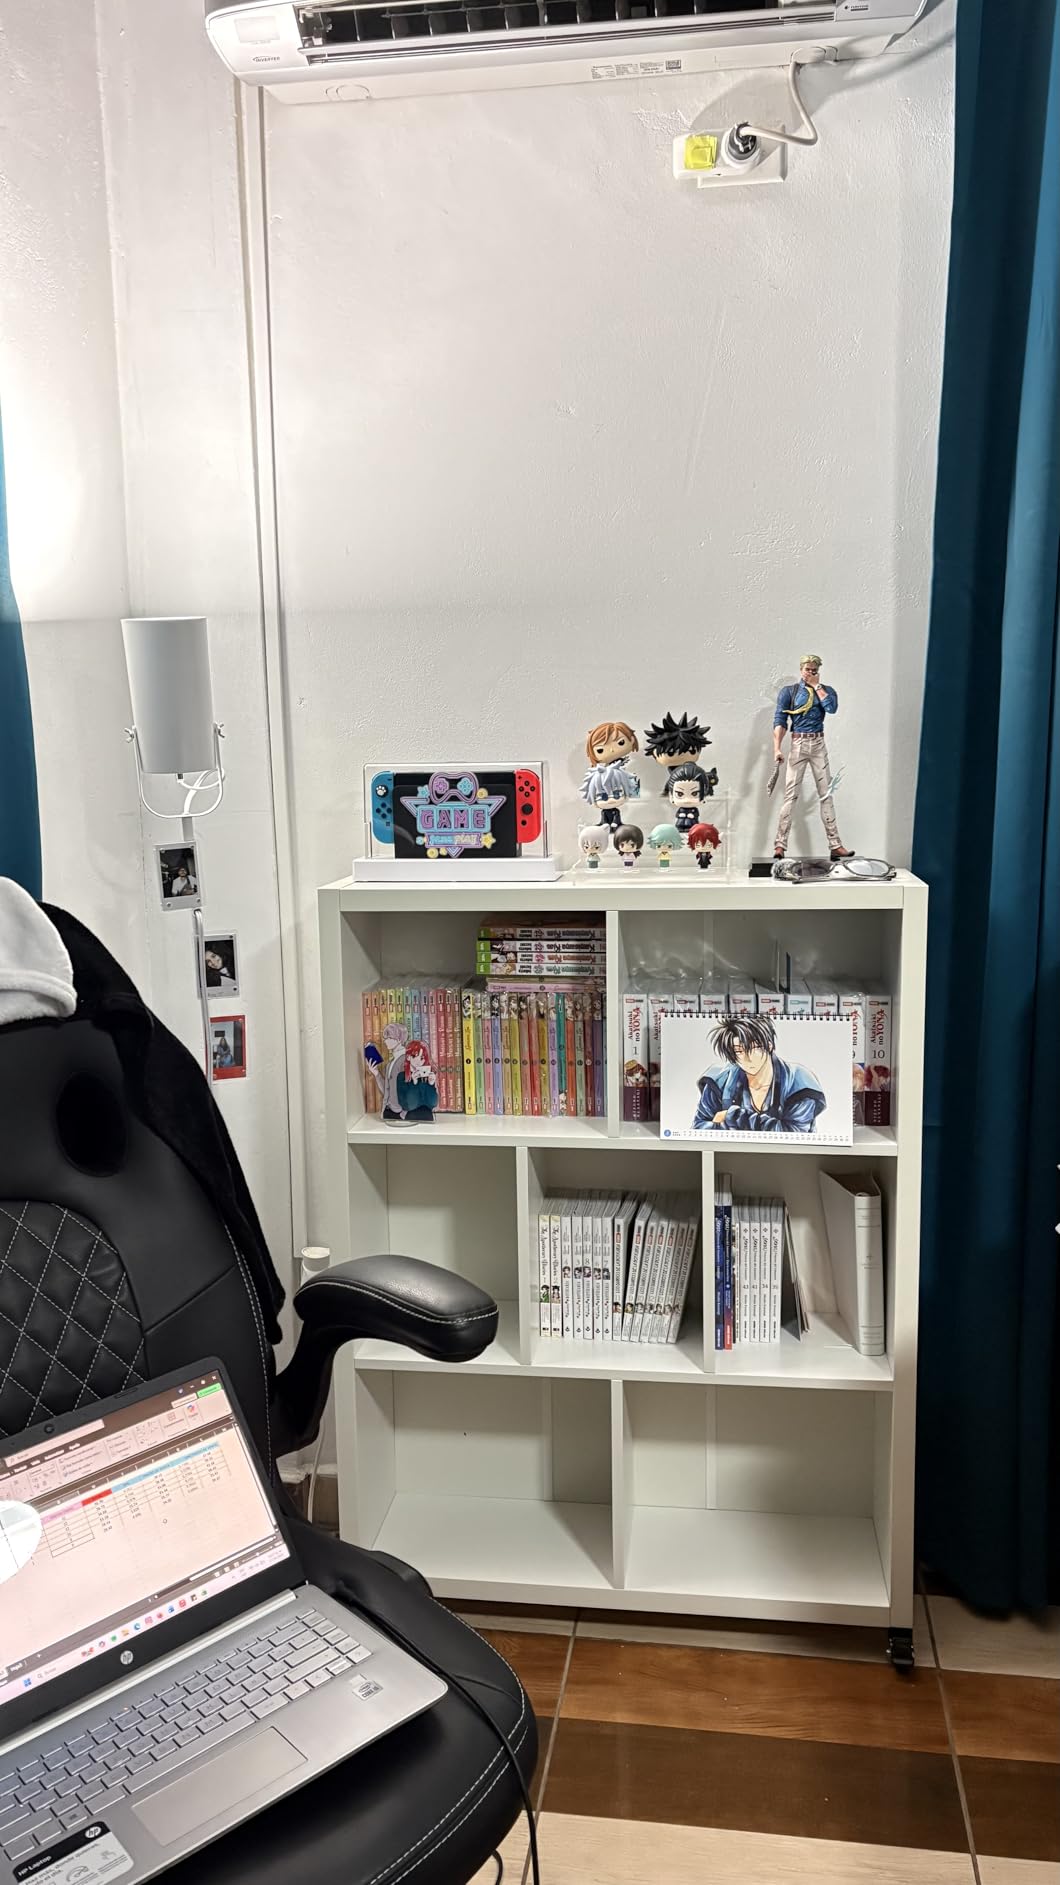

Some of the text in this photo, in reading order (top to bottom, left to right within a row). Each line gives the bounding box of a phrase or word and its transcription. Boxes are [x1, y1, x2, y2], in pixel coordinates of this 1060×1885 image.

[421, 809, 486, 829] GAME
[632, 1007, 641, 1032] YONA
[876, 1009, 885, 1045] no YONA
[633, 1046, 638, 1055] 1
[872, 1049, 885, 1059] 10
[120, 1650, 134, 1665] hp
[362, 1689, 373, 1698] CORE
[86, 1826, 101, 1838] hp
[18, 1855, 52, 1876] HP Laptop
